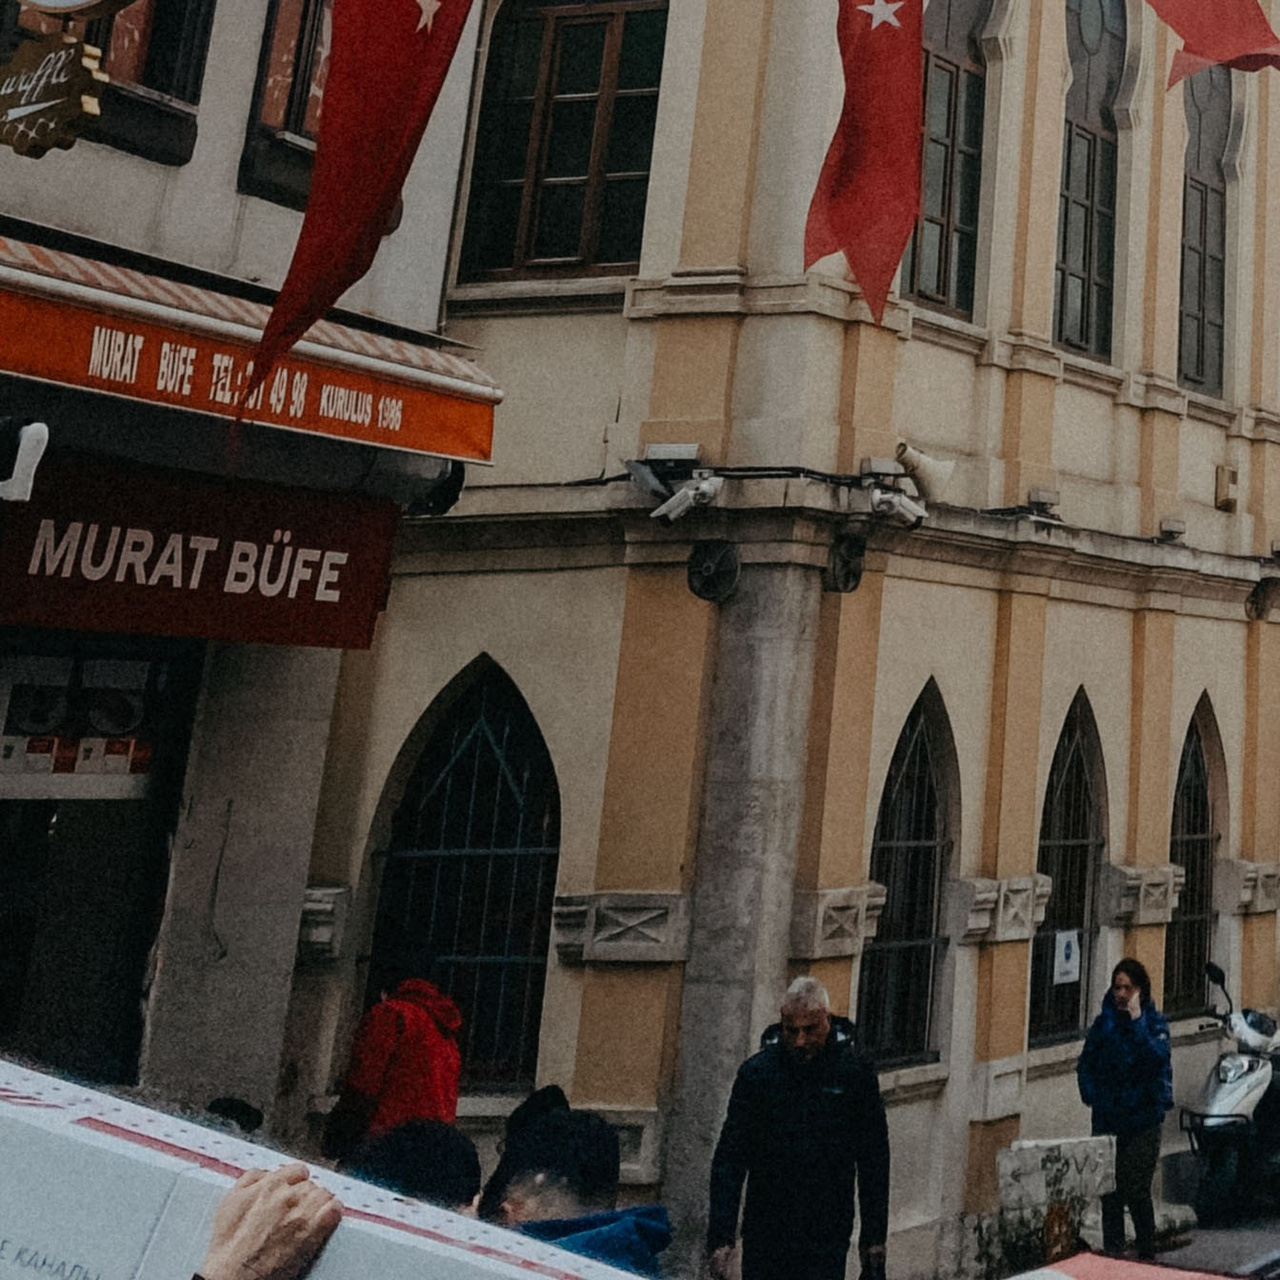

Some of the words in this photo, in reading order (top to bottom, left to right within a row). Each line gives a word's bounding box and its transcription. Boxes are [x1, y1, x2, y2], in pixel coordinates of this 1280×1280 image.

[88, 325, 145, 384] MURAT
[157, 342, 197, 396] BÜFE
[269, 366, 288, 414] 49
[289, 371, 308, 418] 98
[378, 396, 403, 432] 1986
[27, 518, 219, 590] MURAT
[223, 529, 349, 603] BÜFE
